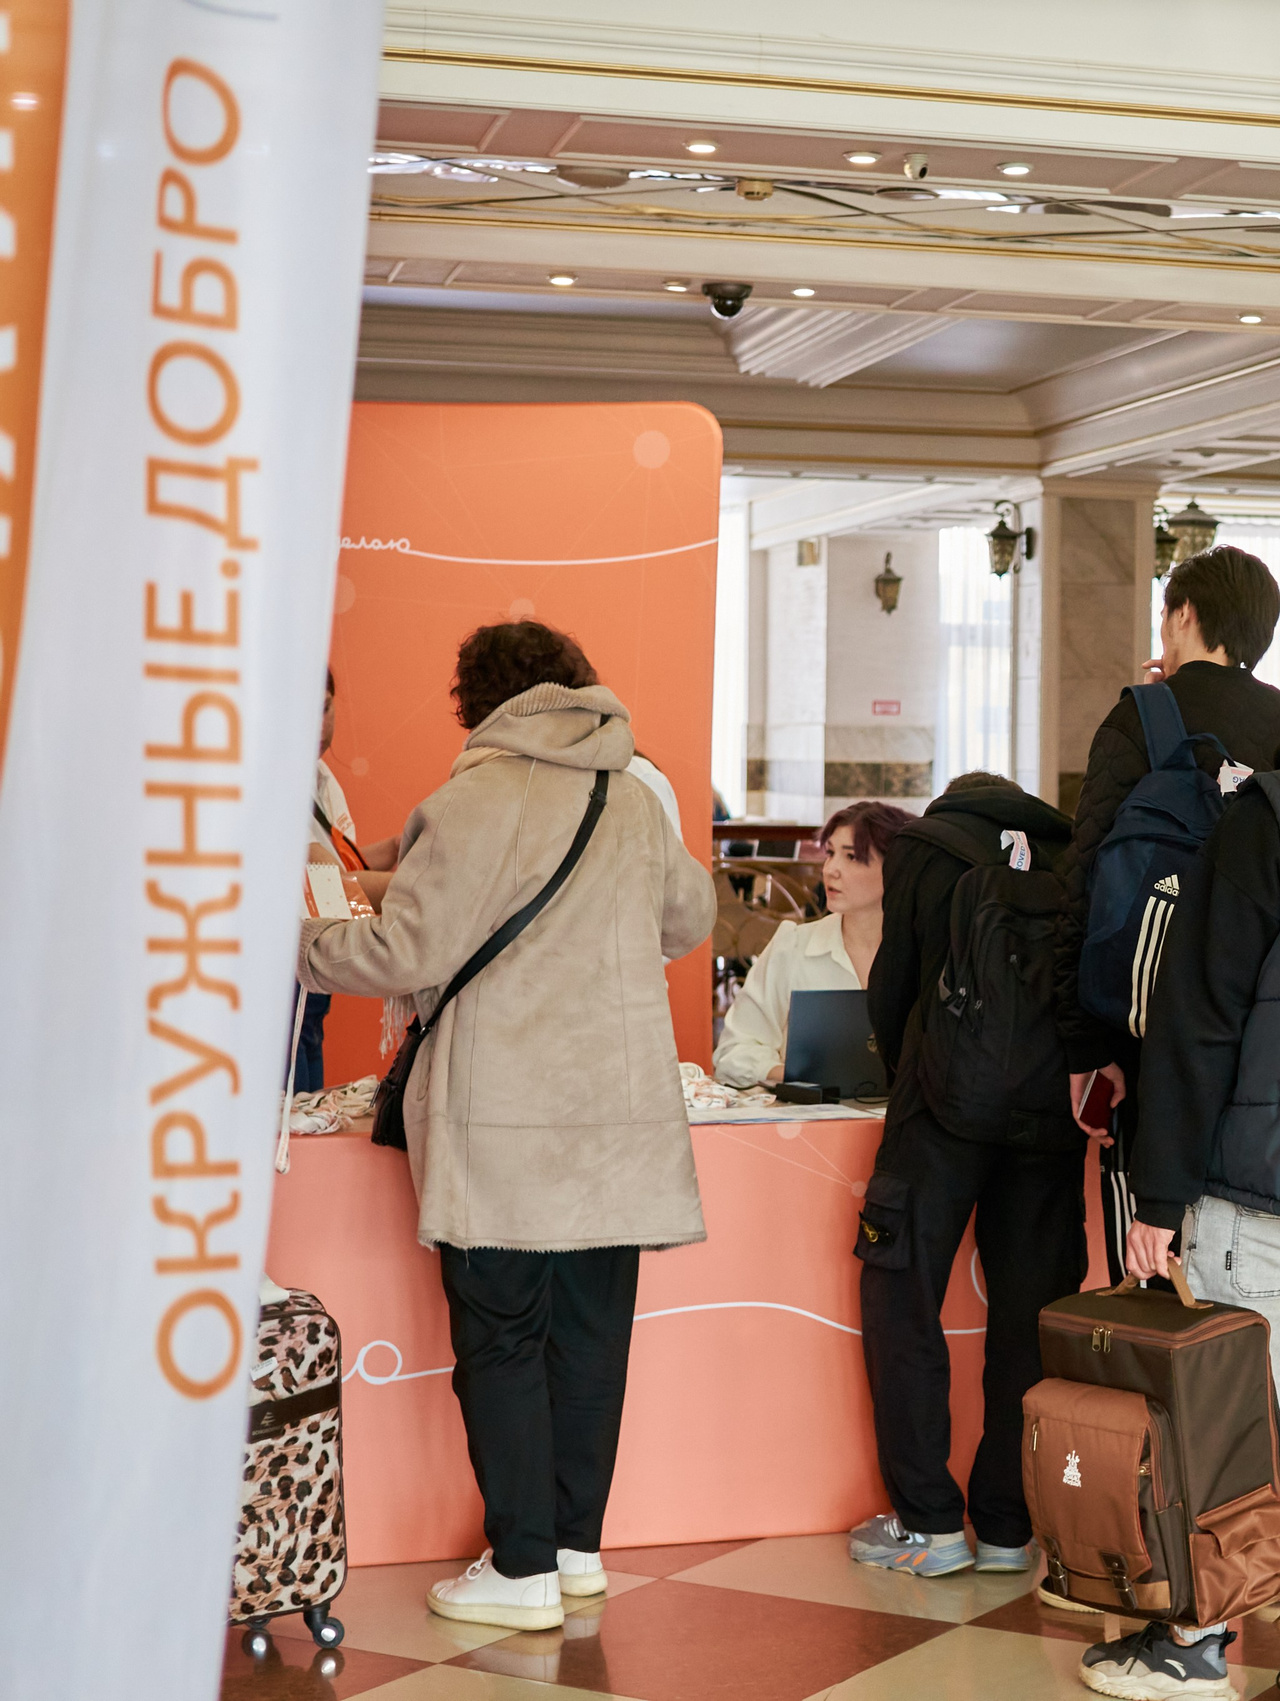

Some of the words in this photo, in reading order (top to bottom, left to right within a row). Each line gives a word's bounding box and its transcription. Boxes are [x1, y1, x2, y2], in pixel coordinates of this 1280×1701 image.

[340, 536, 410, 552] елаю
[143, 56, 259, 1400] ОКРУЖНЫЕ.ДОБРО
[1233, 776, 1247, 784] AG
[1153, 882, 1180, 897] adida
